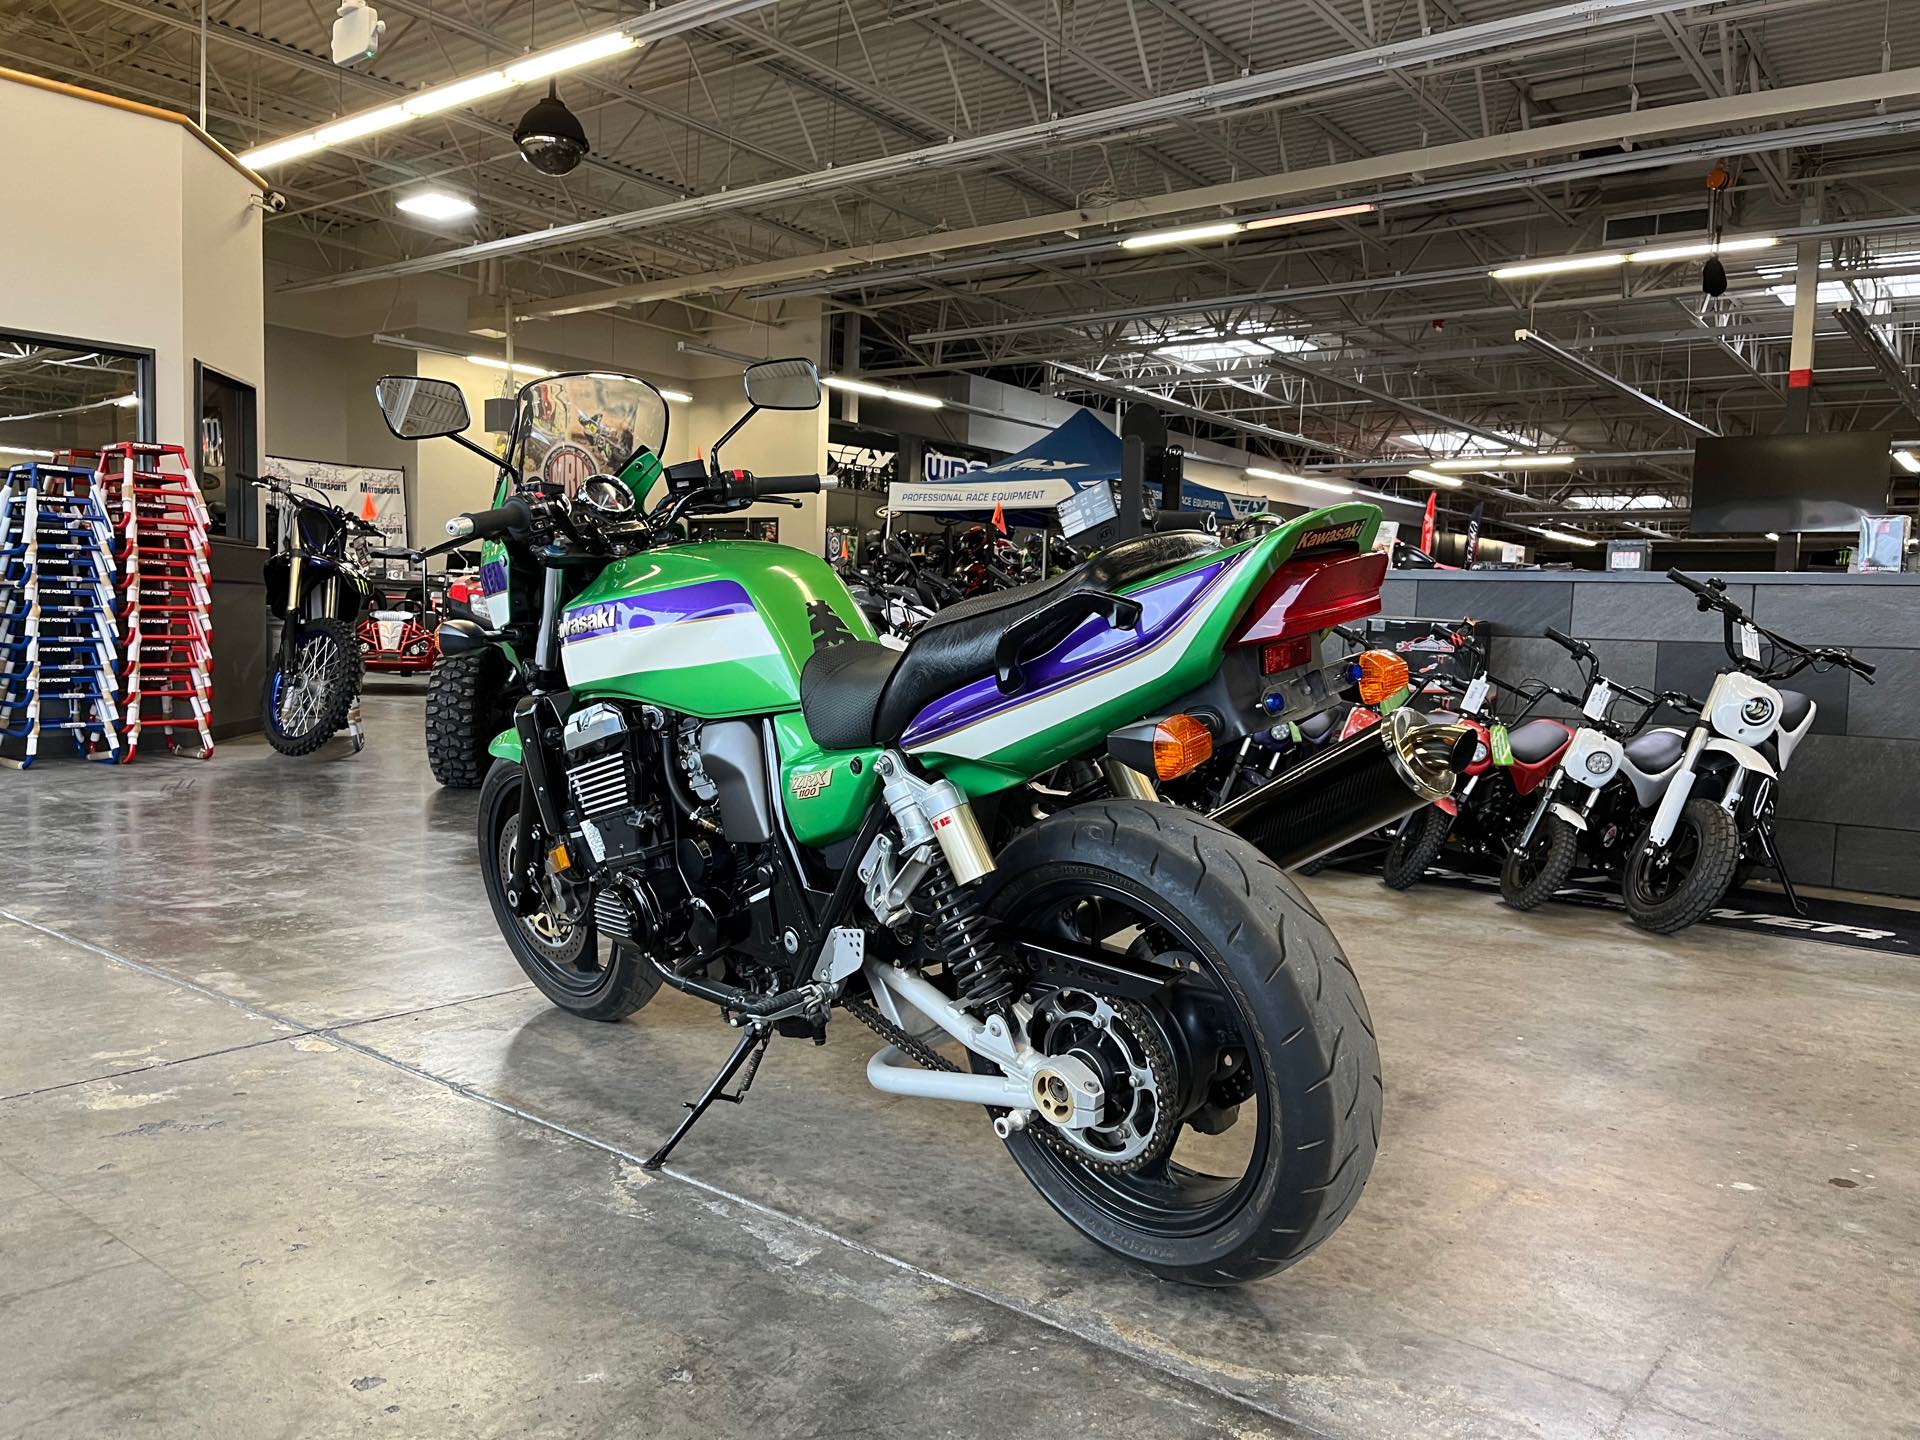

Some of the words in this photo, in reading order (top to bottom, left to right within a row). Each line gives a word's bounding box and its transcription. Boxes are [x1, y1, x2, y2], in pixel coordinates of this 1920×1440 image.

[828, 442, 896, 468] FLY
[305, 477, 348, 492] MOTORSPORTS
[360, 482, 400, 495] MOTORSPORTS
[902, 493, 963, 501] PROFESSIONAL
[966, 492, 989, 501] RACE
[992, 490, 1046, 501] EQUIPMENT
[1181, 496, 1191, 506] ACE
[1193, 498, 1224, 510] EQUIPMENT
[1231, 500, 1267, 513] FLY
[1296, 520, 1366, 550] Kawasaki
[792, 770, 827, 790] ZRX
[799, 787, 817, 798] 1100
